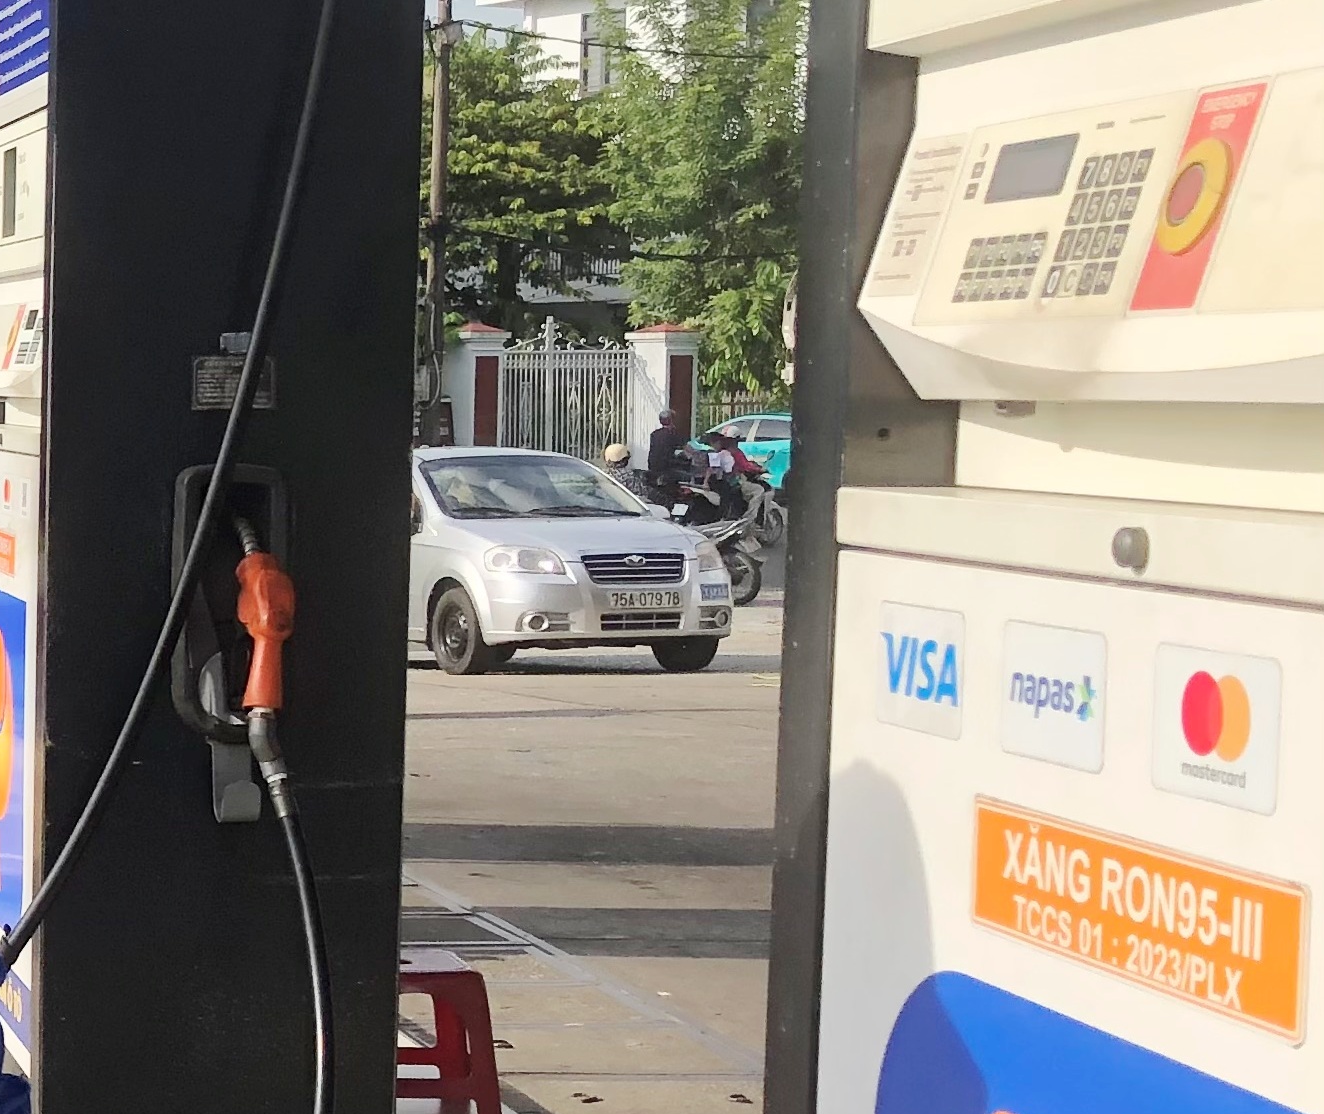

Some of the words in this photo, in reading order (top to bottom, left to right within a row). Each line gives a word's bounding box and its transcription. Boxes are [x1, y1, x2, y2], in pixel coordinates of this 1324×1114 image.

[880, 632, 959, 708] VISA
[1009, 671, 1075, 719] napas
[1180, 761, 1247, 789] mastercard
[1002, 822, 1091, 903] XĂNG
[1100, 857, 1264, 962] RON95-III
[1013, 894, 1072, 948] TCCS
[1079, 918, 1103, 960] 01
[1125, 934, 1243, 1012] 2023/PLX
